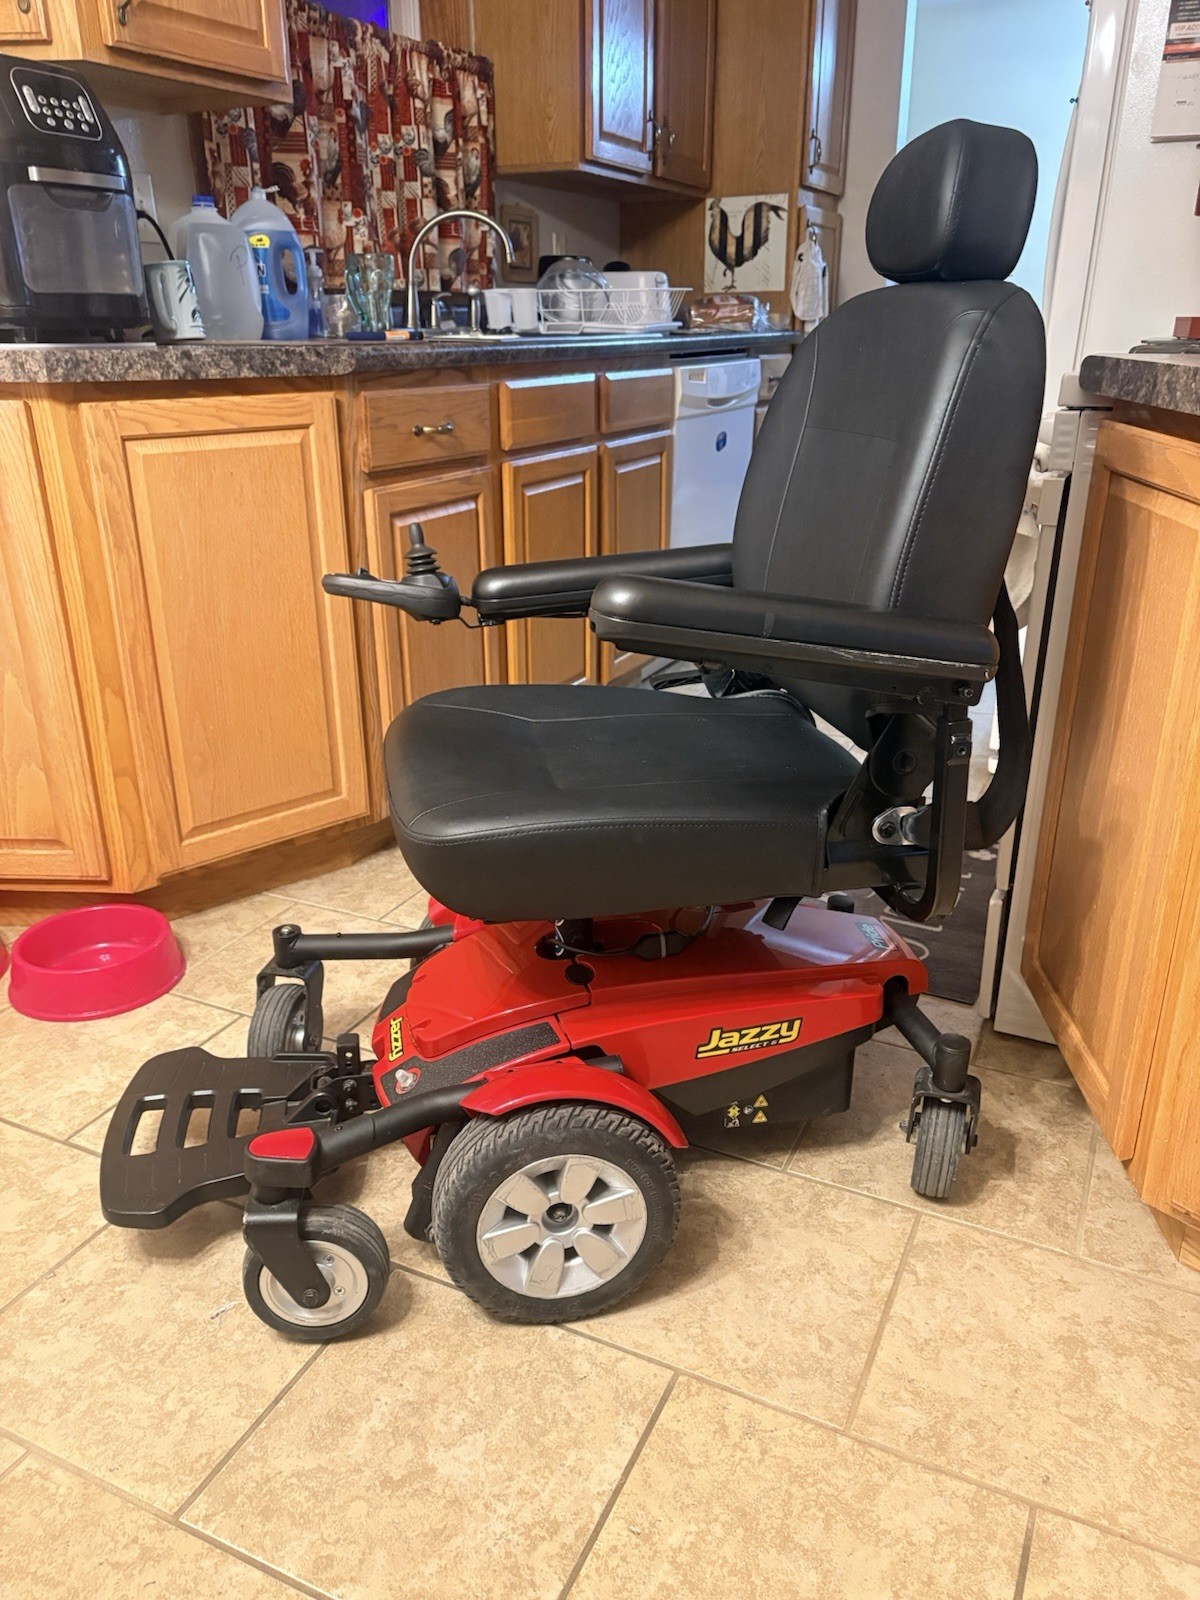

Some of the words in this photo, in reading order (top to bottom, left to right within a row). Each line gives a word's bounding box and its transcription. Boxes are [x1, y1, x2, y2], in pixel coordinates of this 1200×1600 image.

[388, 1016, 404, 1062] Jazzy
[696, 1018, 802, 1055] Jazzy
[731, 1041, 767, 1053] SELECT
